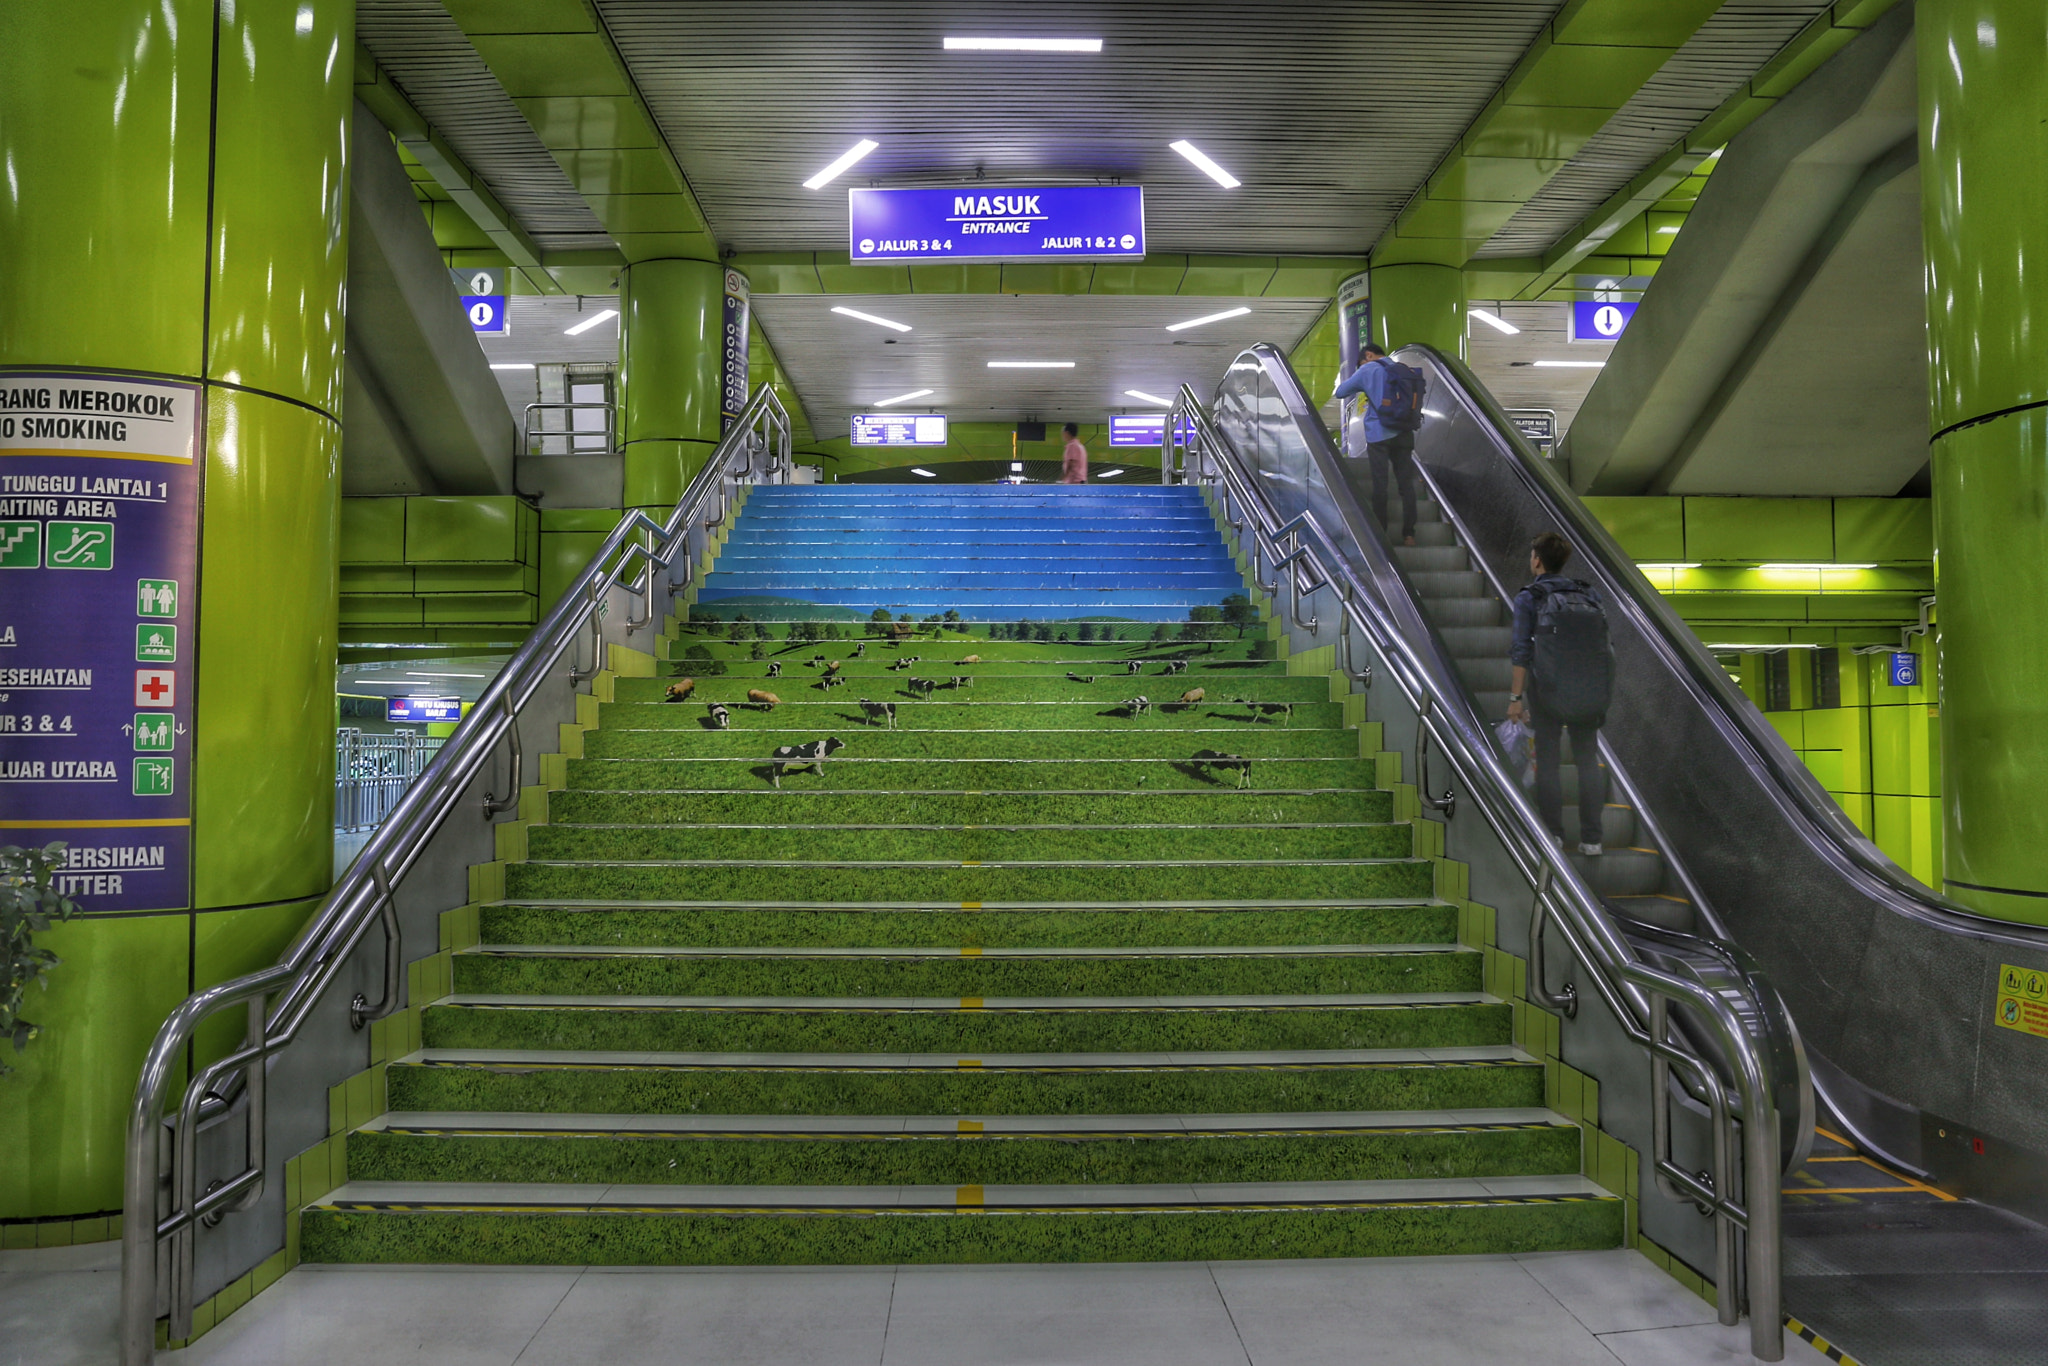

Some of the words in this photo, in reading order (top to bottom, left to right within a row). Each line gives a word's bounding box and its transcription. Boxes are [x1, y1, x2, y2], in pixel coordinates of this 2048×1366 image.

[953, 195, 1041, 216] MASUK
[961, 221, 1031, 234] ENTRANCE
[877, 240, 918, 252] JALUR
[920, 239, 929, 251] 3
[931, 239, 942, 250] &
[942, 239, 952, 250] 4
[1041, 237, 1083, 249] JALUR
[1086, 237, 1092, 248] 1
[1095, 237, 1106, 248] &
[1107, 237, 1116, 248] 2
[58, 389, 174, 417] MEROKOK
[0, 418, 15, 438] O
[21, 418, 127, 441] SMOKING
[2, 475, 75, 493] TUNGGU
[82, 476, 150, 496] LANTAI
[158, 482, 167, 498] 1
[63, 500, 117, 518] AREA
[0, 668, 92, 685] ESEHATAN
[21, 715, 33, 732] 3
[39, 715, 54, 732] &
[60, 715, 73, 732] 4
[51, 761, 117, 778] UTARA
[47, 874, 122, 895] ITTER
